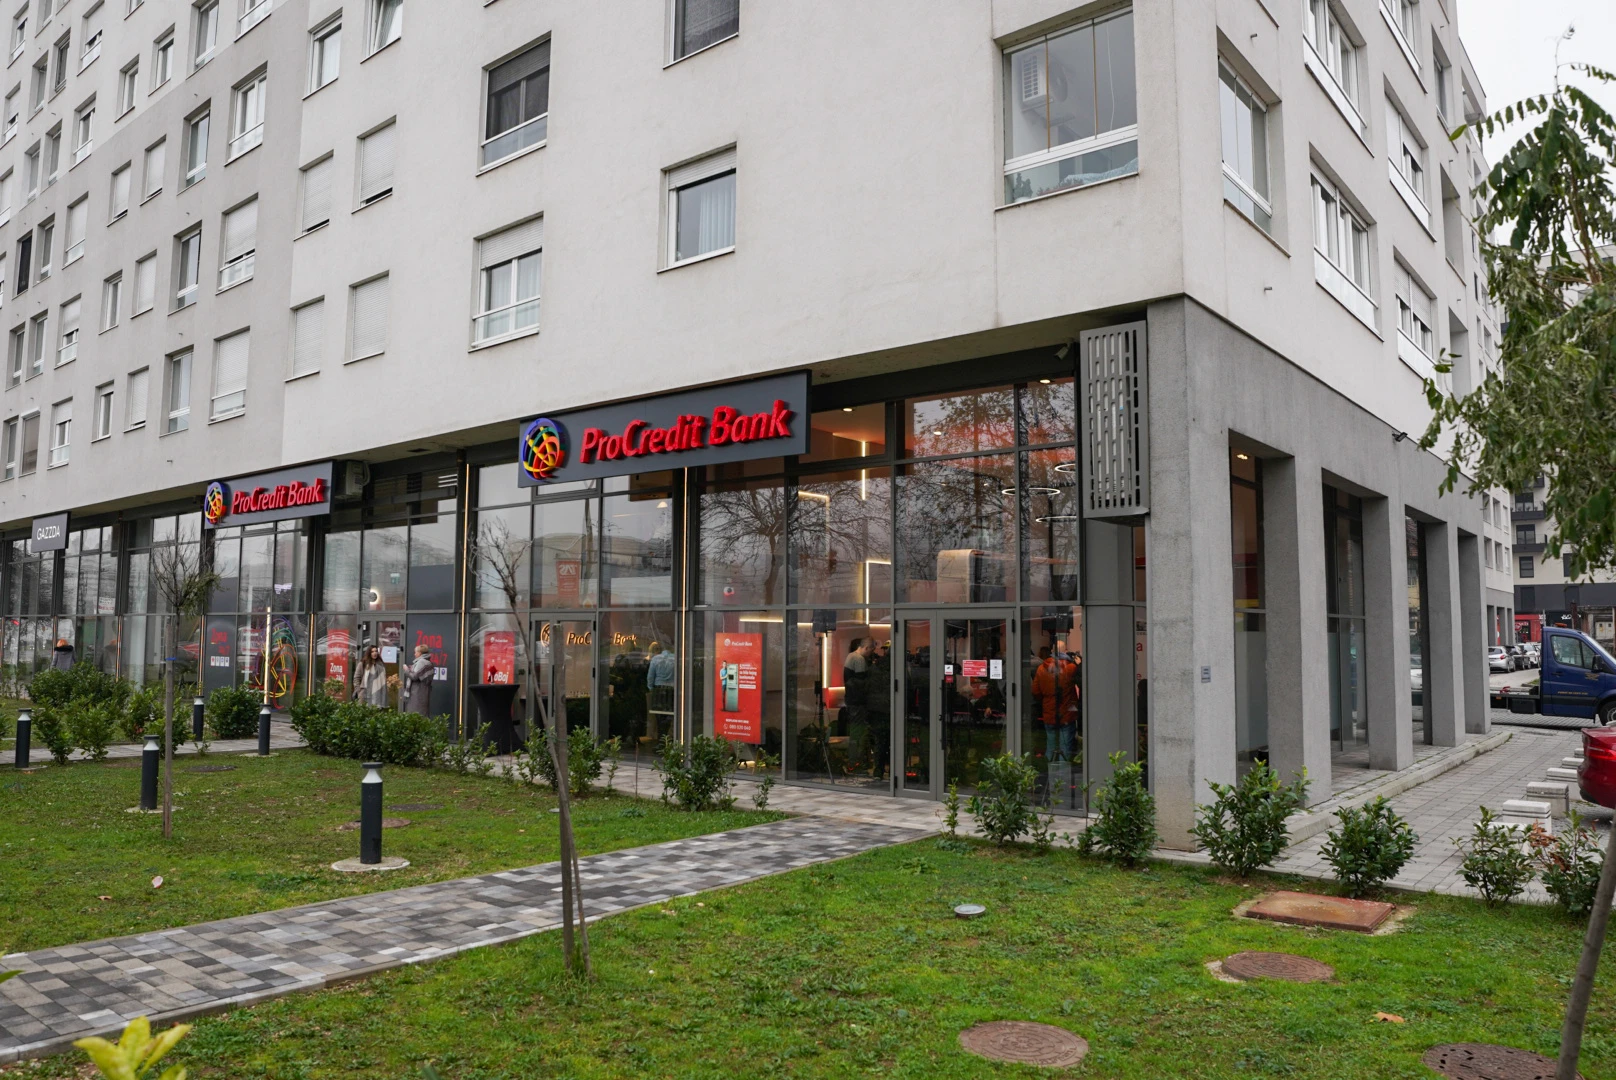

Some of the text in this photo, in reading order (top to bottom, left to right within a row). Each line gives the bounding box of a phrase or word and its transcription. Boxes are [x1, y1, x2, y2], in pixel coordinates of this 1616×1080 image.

[579, 399, 793, 463] ProCredit Bank
[231, 478, 324, 514] ProCredit Bank
[36, 525, 60, 540] GAZZDA
